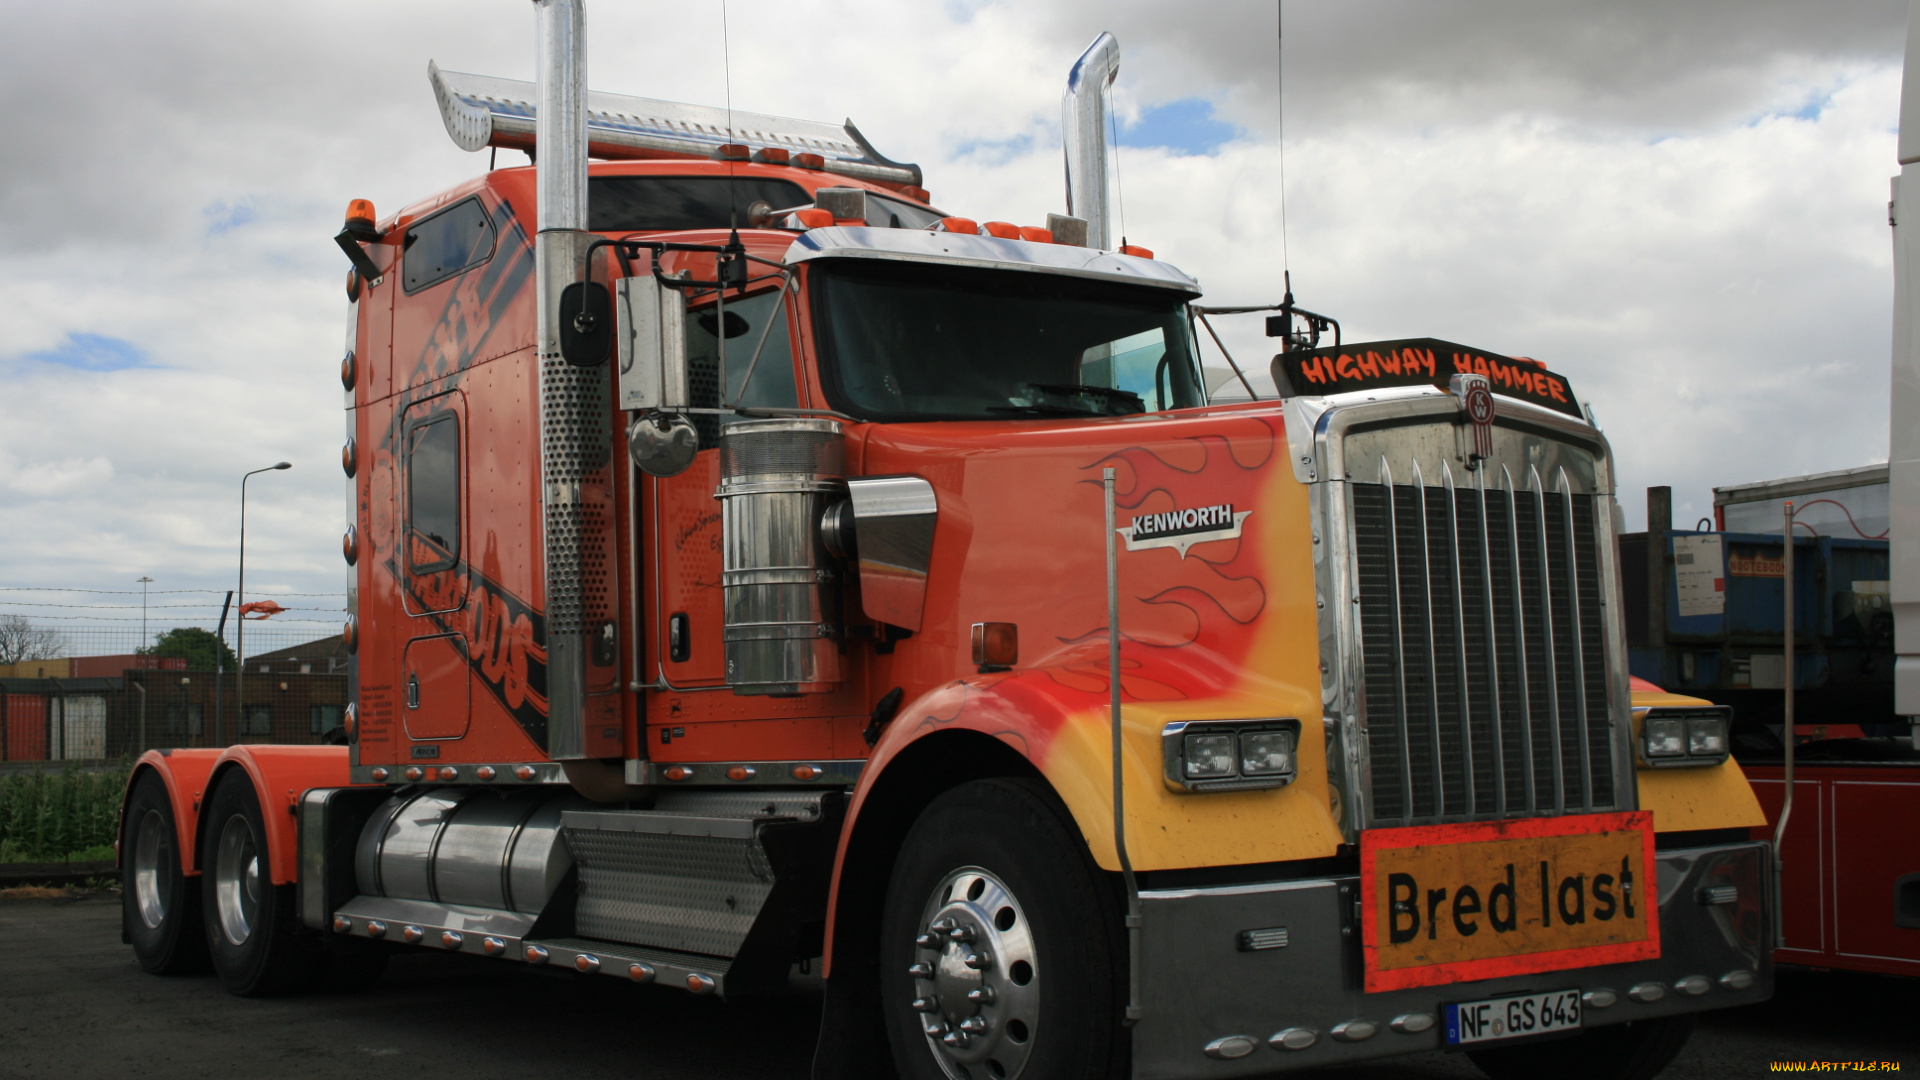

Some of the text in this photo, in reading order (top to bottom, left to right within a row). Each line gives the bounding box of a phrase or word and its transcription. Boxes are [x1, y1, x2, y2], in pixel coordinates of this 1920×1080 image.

[1301, 347, 1567, 403] HIGHWAY HAMMER
[1132, 504, 1232, 535] KENWORTH
[1730, 560, 1784, 573] NOOTEBOO
[1388, 855, 1635, 944] Bred last
[1460, 1004, 1491, 1040] NF
[1506, 999, 1535, 1033] GS
[1540, 992, 1579, 1026] 643
